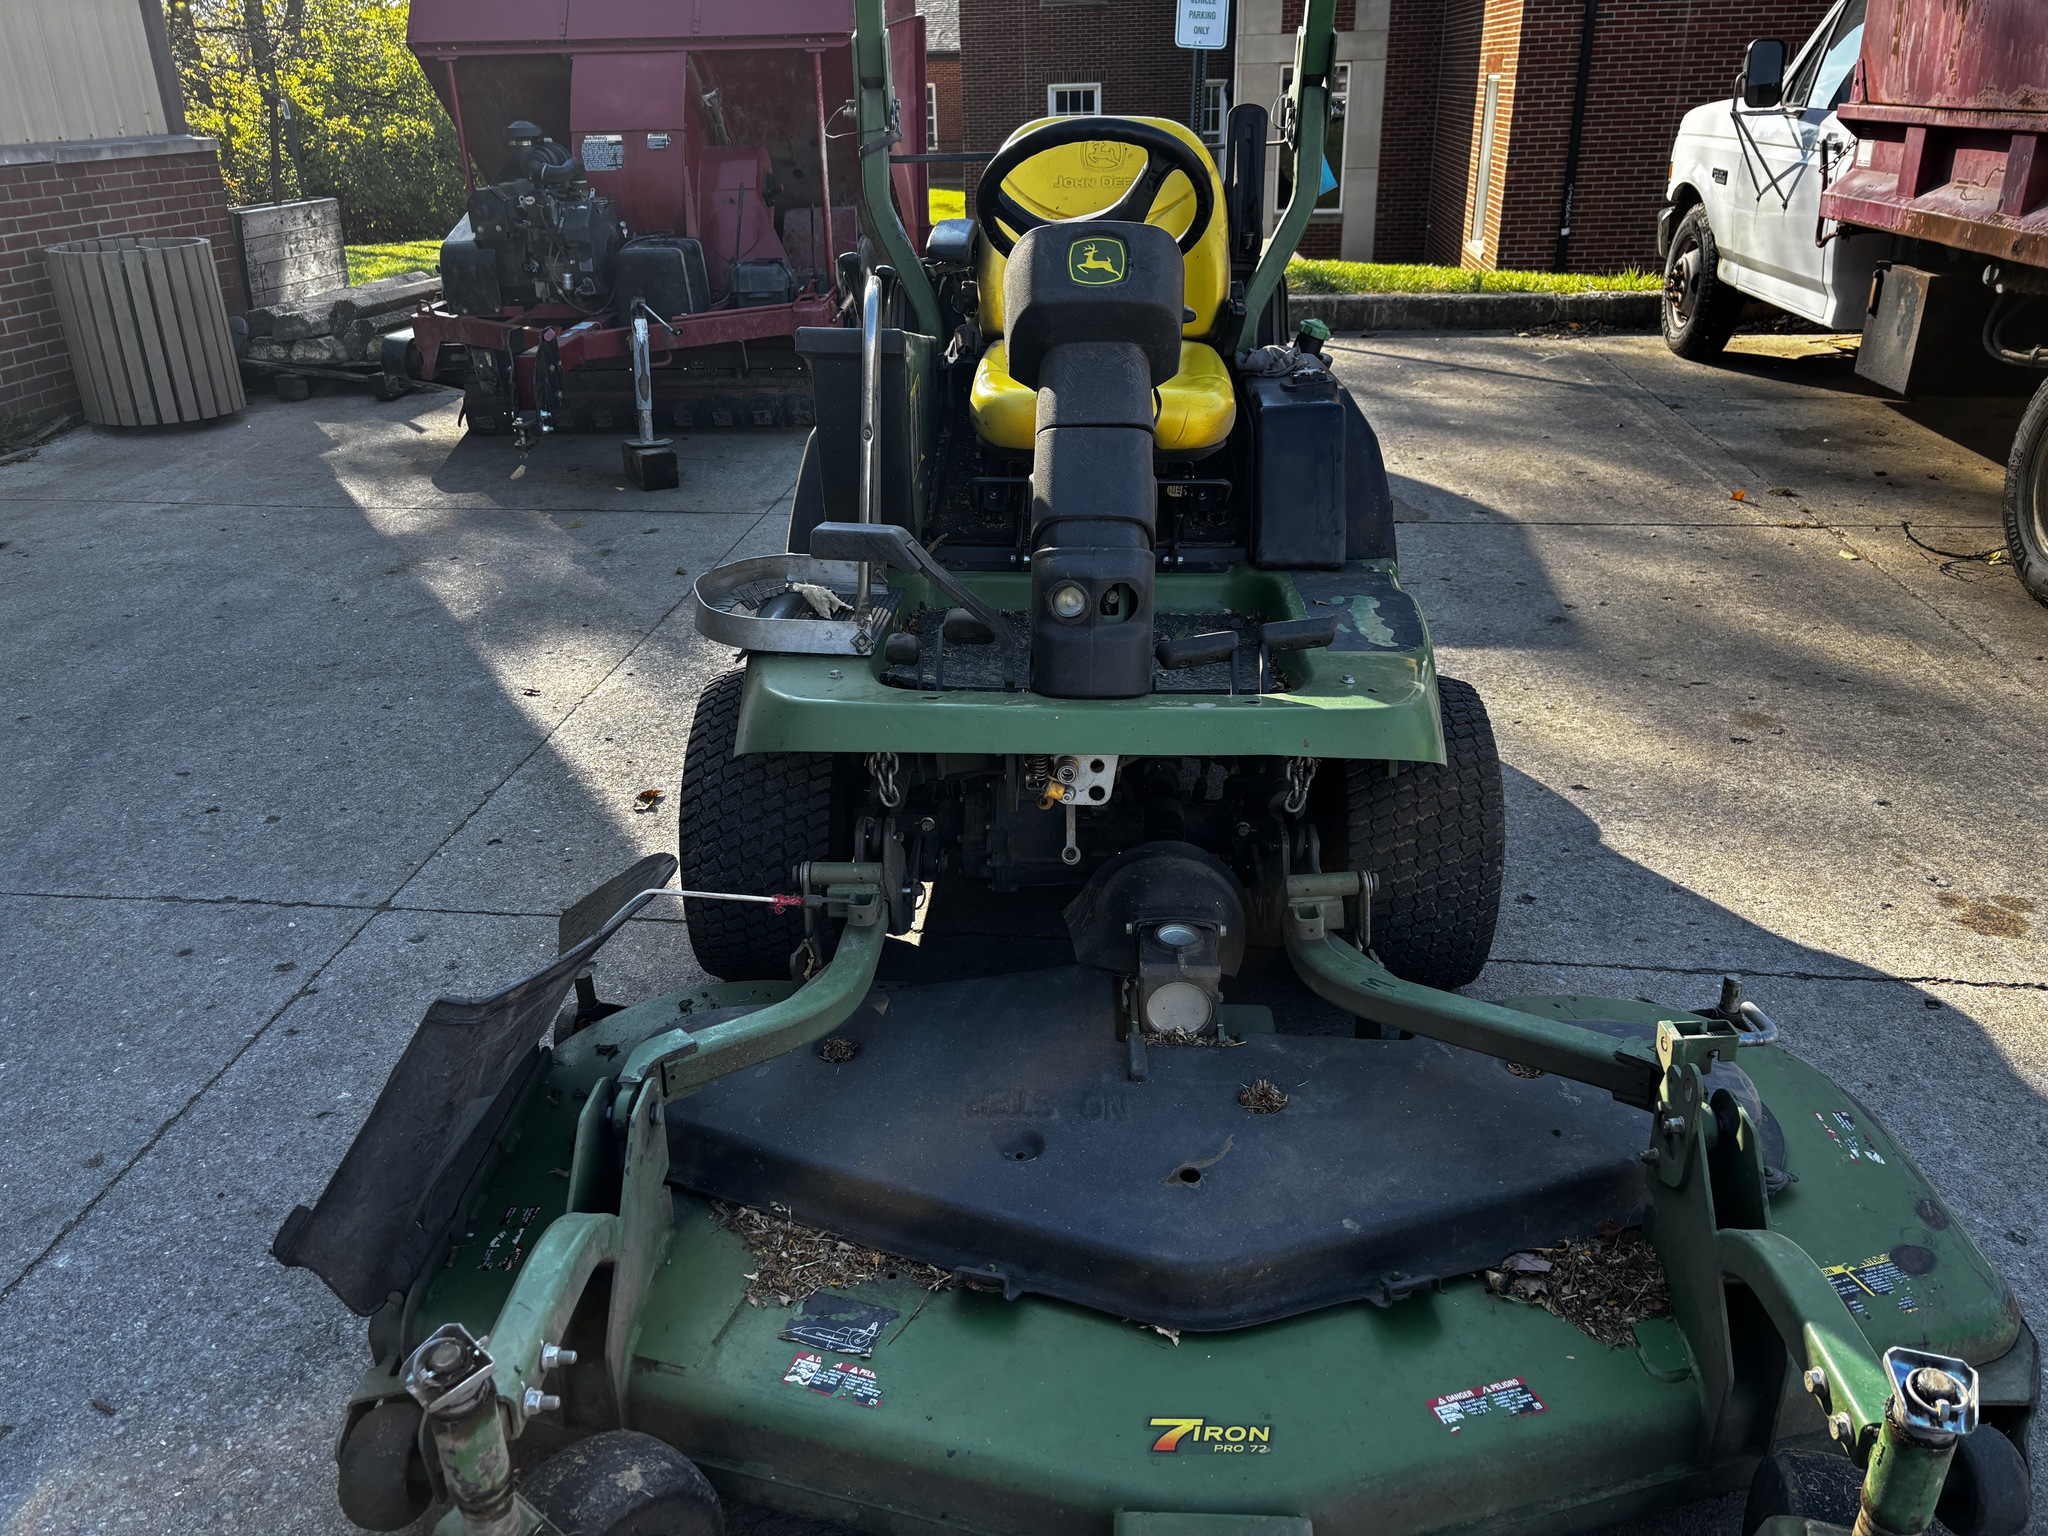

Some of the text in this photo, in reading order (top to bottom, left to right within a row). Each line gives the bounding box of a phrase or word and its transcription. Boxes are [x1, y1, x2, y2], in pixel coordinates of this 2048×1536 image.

[1188, 10, 1217, 20] PARKING
[1193, 25, 1210, 35] ONLY
[1053, 175, 1133, 188] JOHN DEE
[1446, 1378, 1520, 1402] DANGER PELIGRO
[1213, 1444, 1269, 1454] PRO 72
